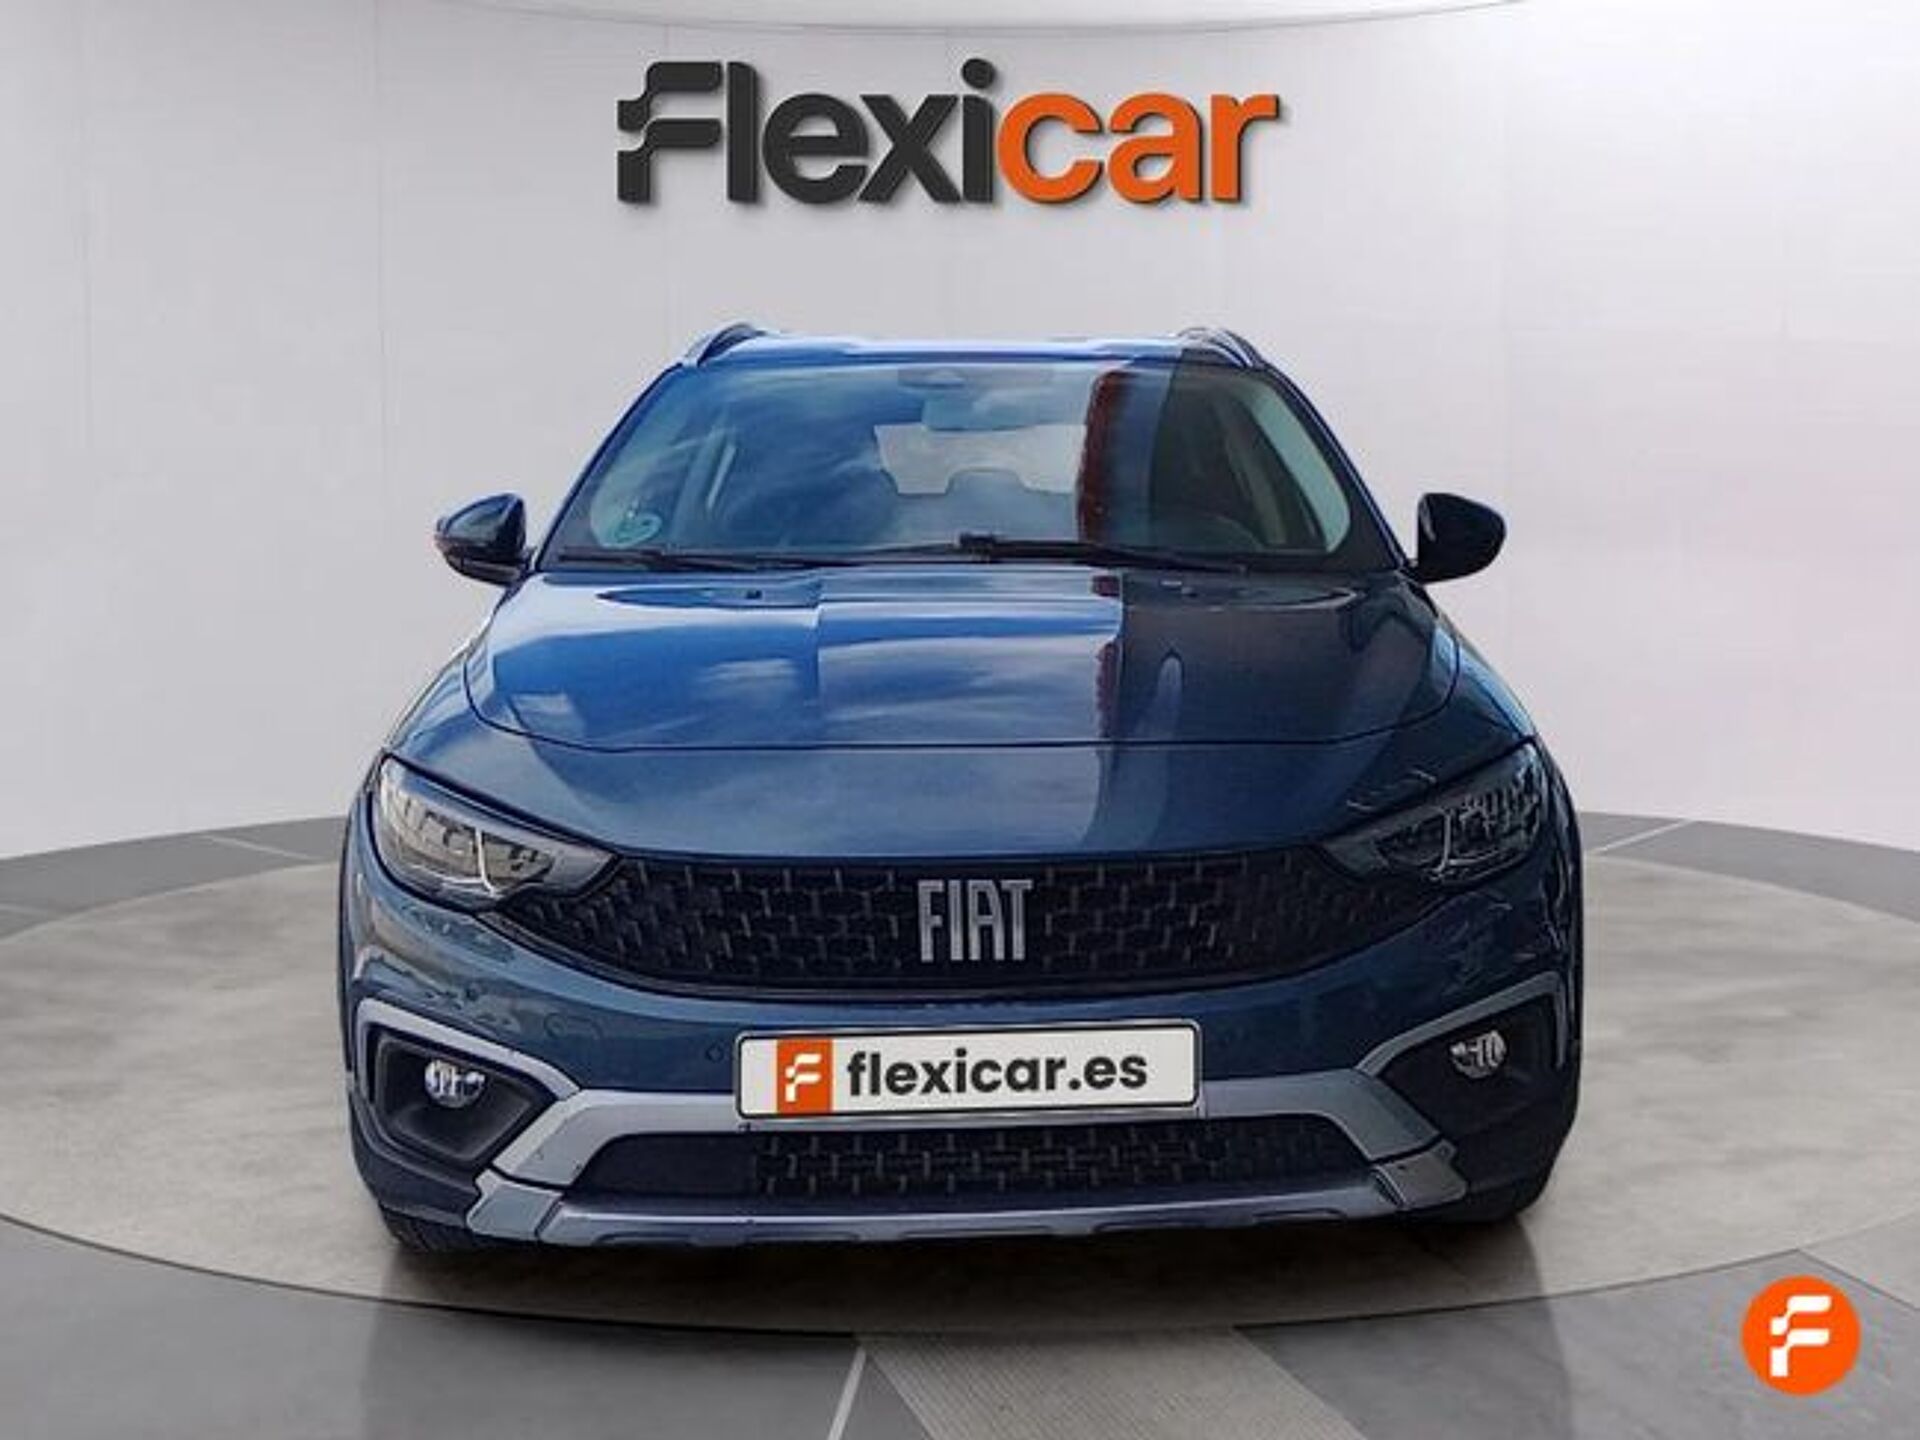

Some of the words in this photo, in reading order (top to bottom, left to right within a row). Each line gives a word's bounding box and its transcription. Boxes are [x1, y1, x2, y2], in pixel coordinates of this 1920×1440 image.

[617, 58, 1279, 203] Flexicar
[917, 879, 1034, 962] FIAT
[847, 1048, 1148, 1096] flexicar.es
